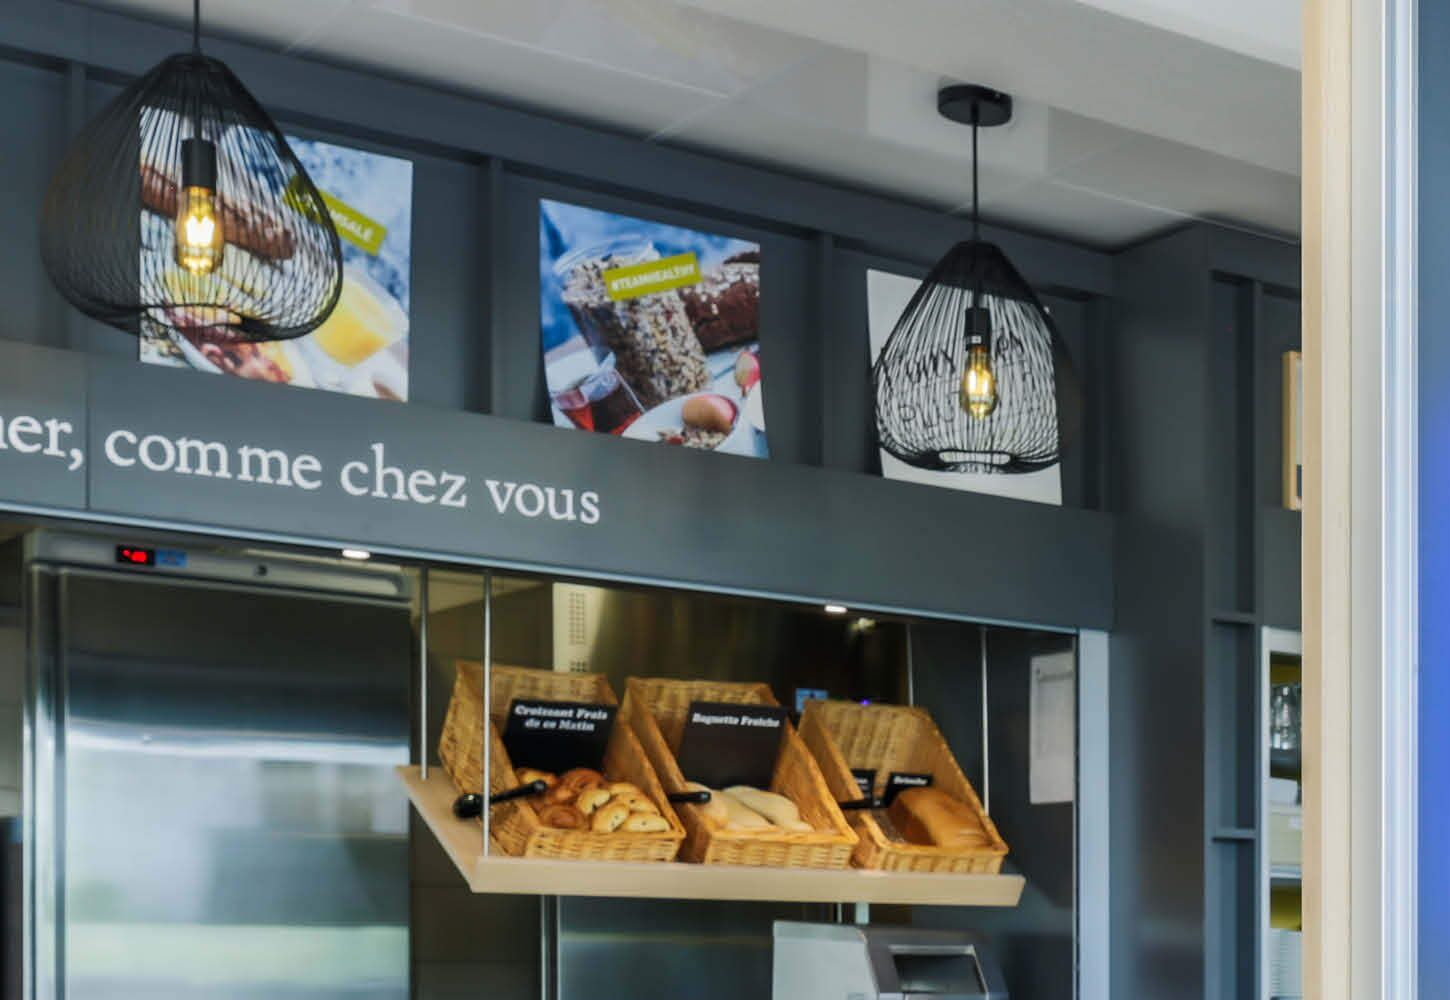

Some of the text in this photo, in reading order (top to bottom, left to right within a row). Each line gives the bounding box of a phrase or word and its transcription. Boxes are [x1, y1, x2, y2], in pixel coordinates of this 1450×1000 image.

[104, 429, 322, 490] comme
[340, 442, 467, 508] chez
[485, 479, 600, 525] vous
